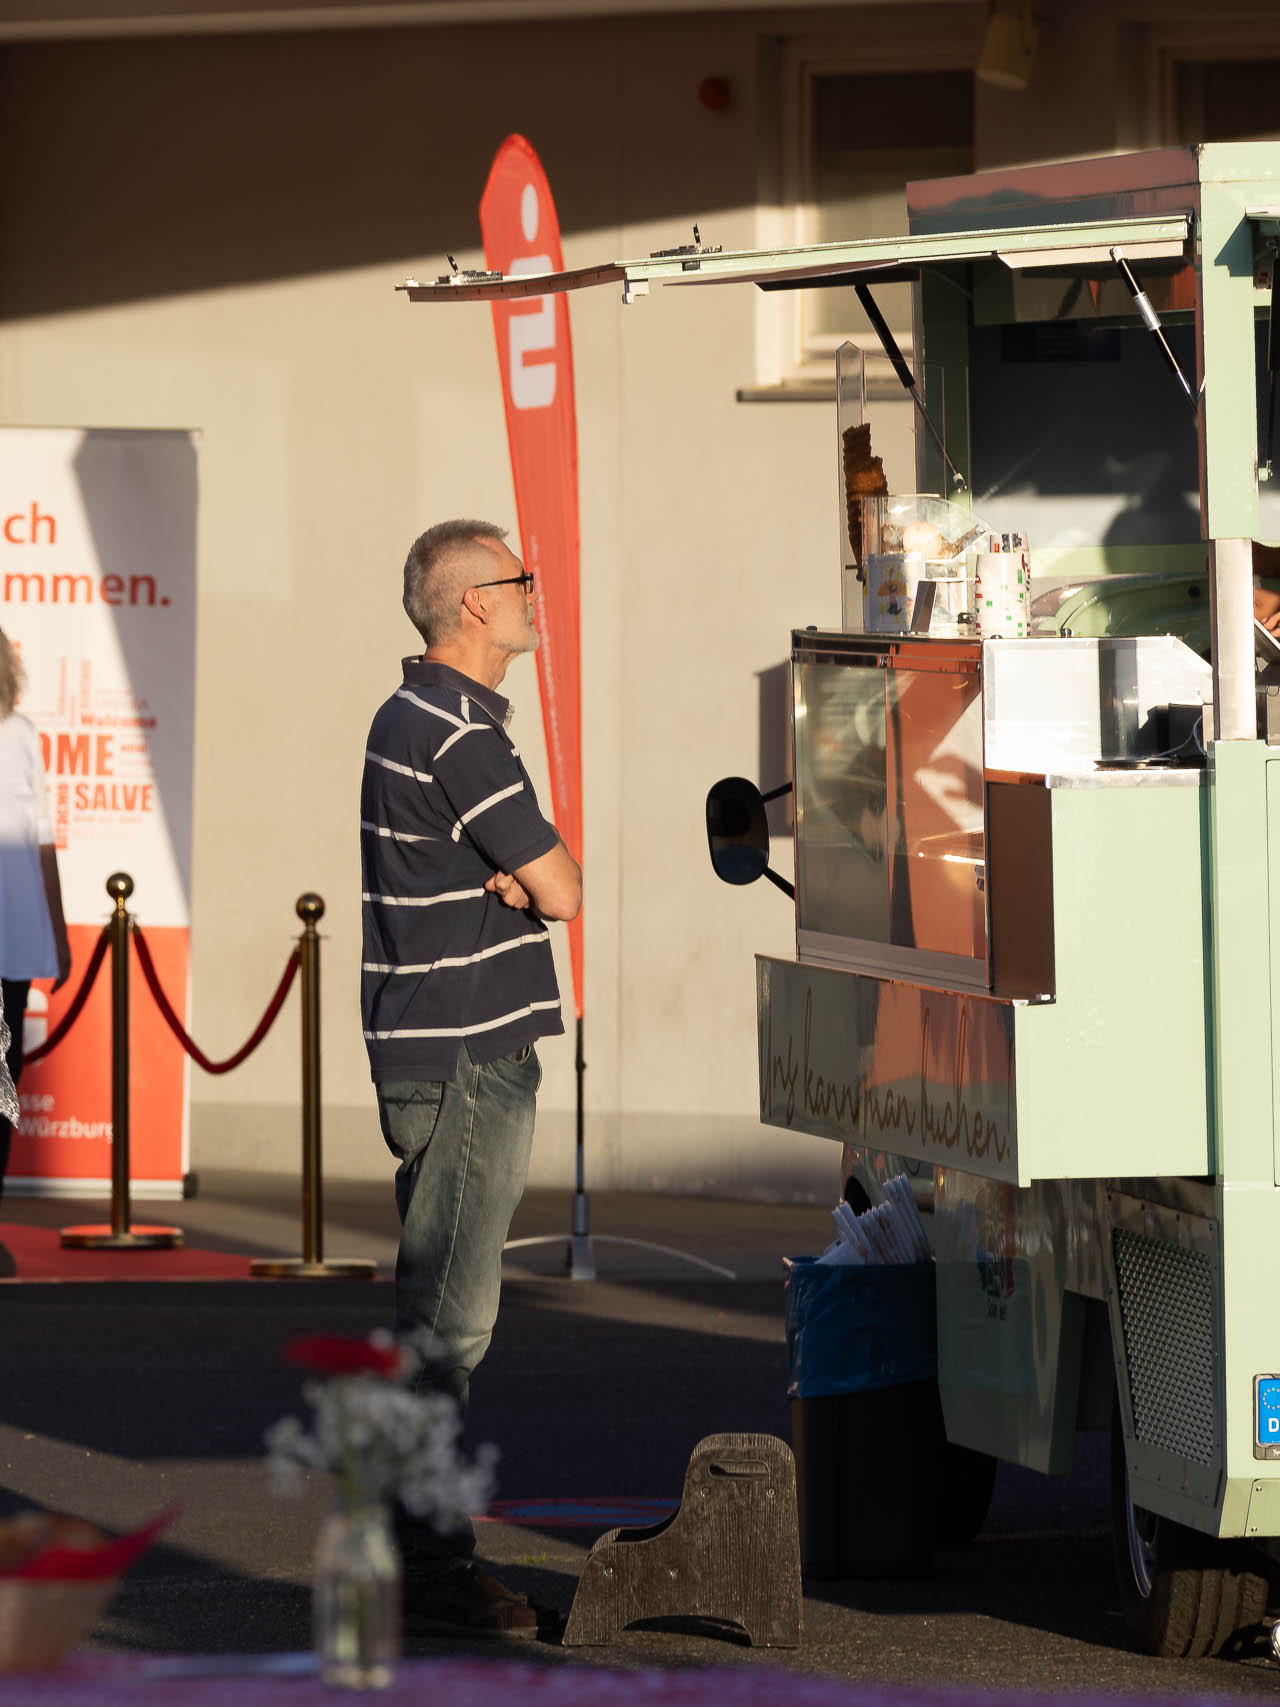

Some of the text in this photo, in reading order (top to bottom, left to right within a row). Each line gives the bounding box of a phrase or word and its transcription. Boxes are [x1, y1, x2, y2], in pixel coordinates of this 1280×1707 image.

[74, 782, 154, 813] SALVE
[804, 986, 861, 1126] kann
[862, 1086, 917, 1141] man
[1268, 1417, 1280, 1432] D
